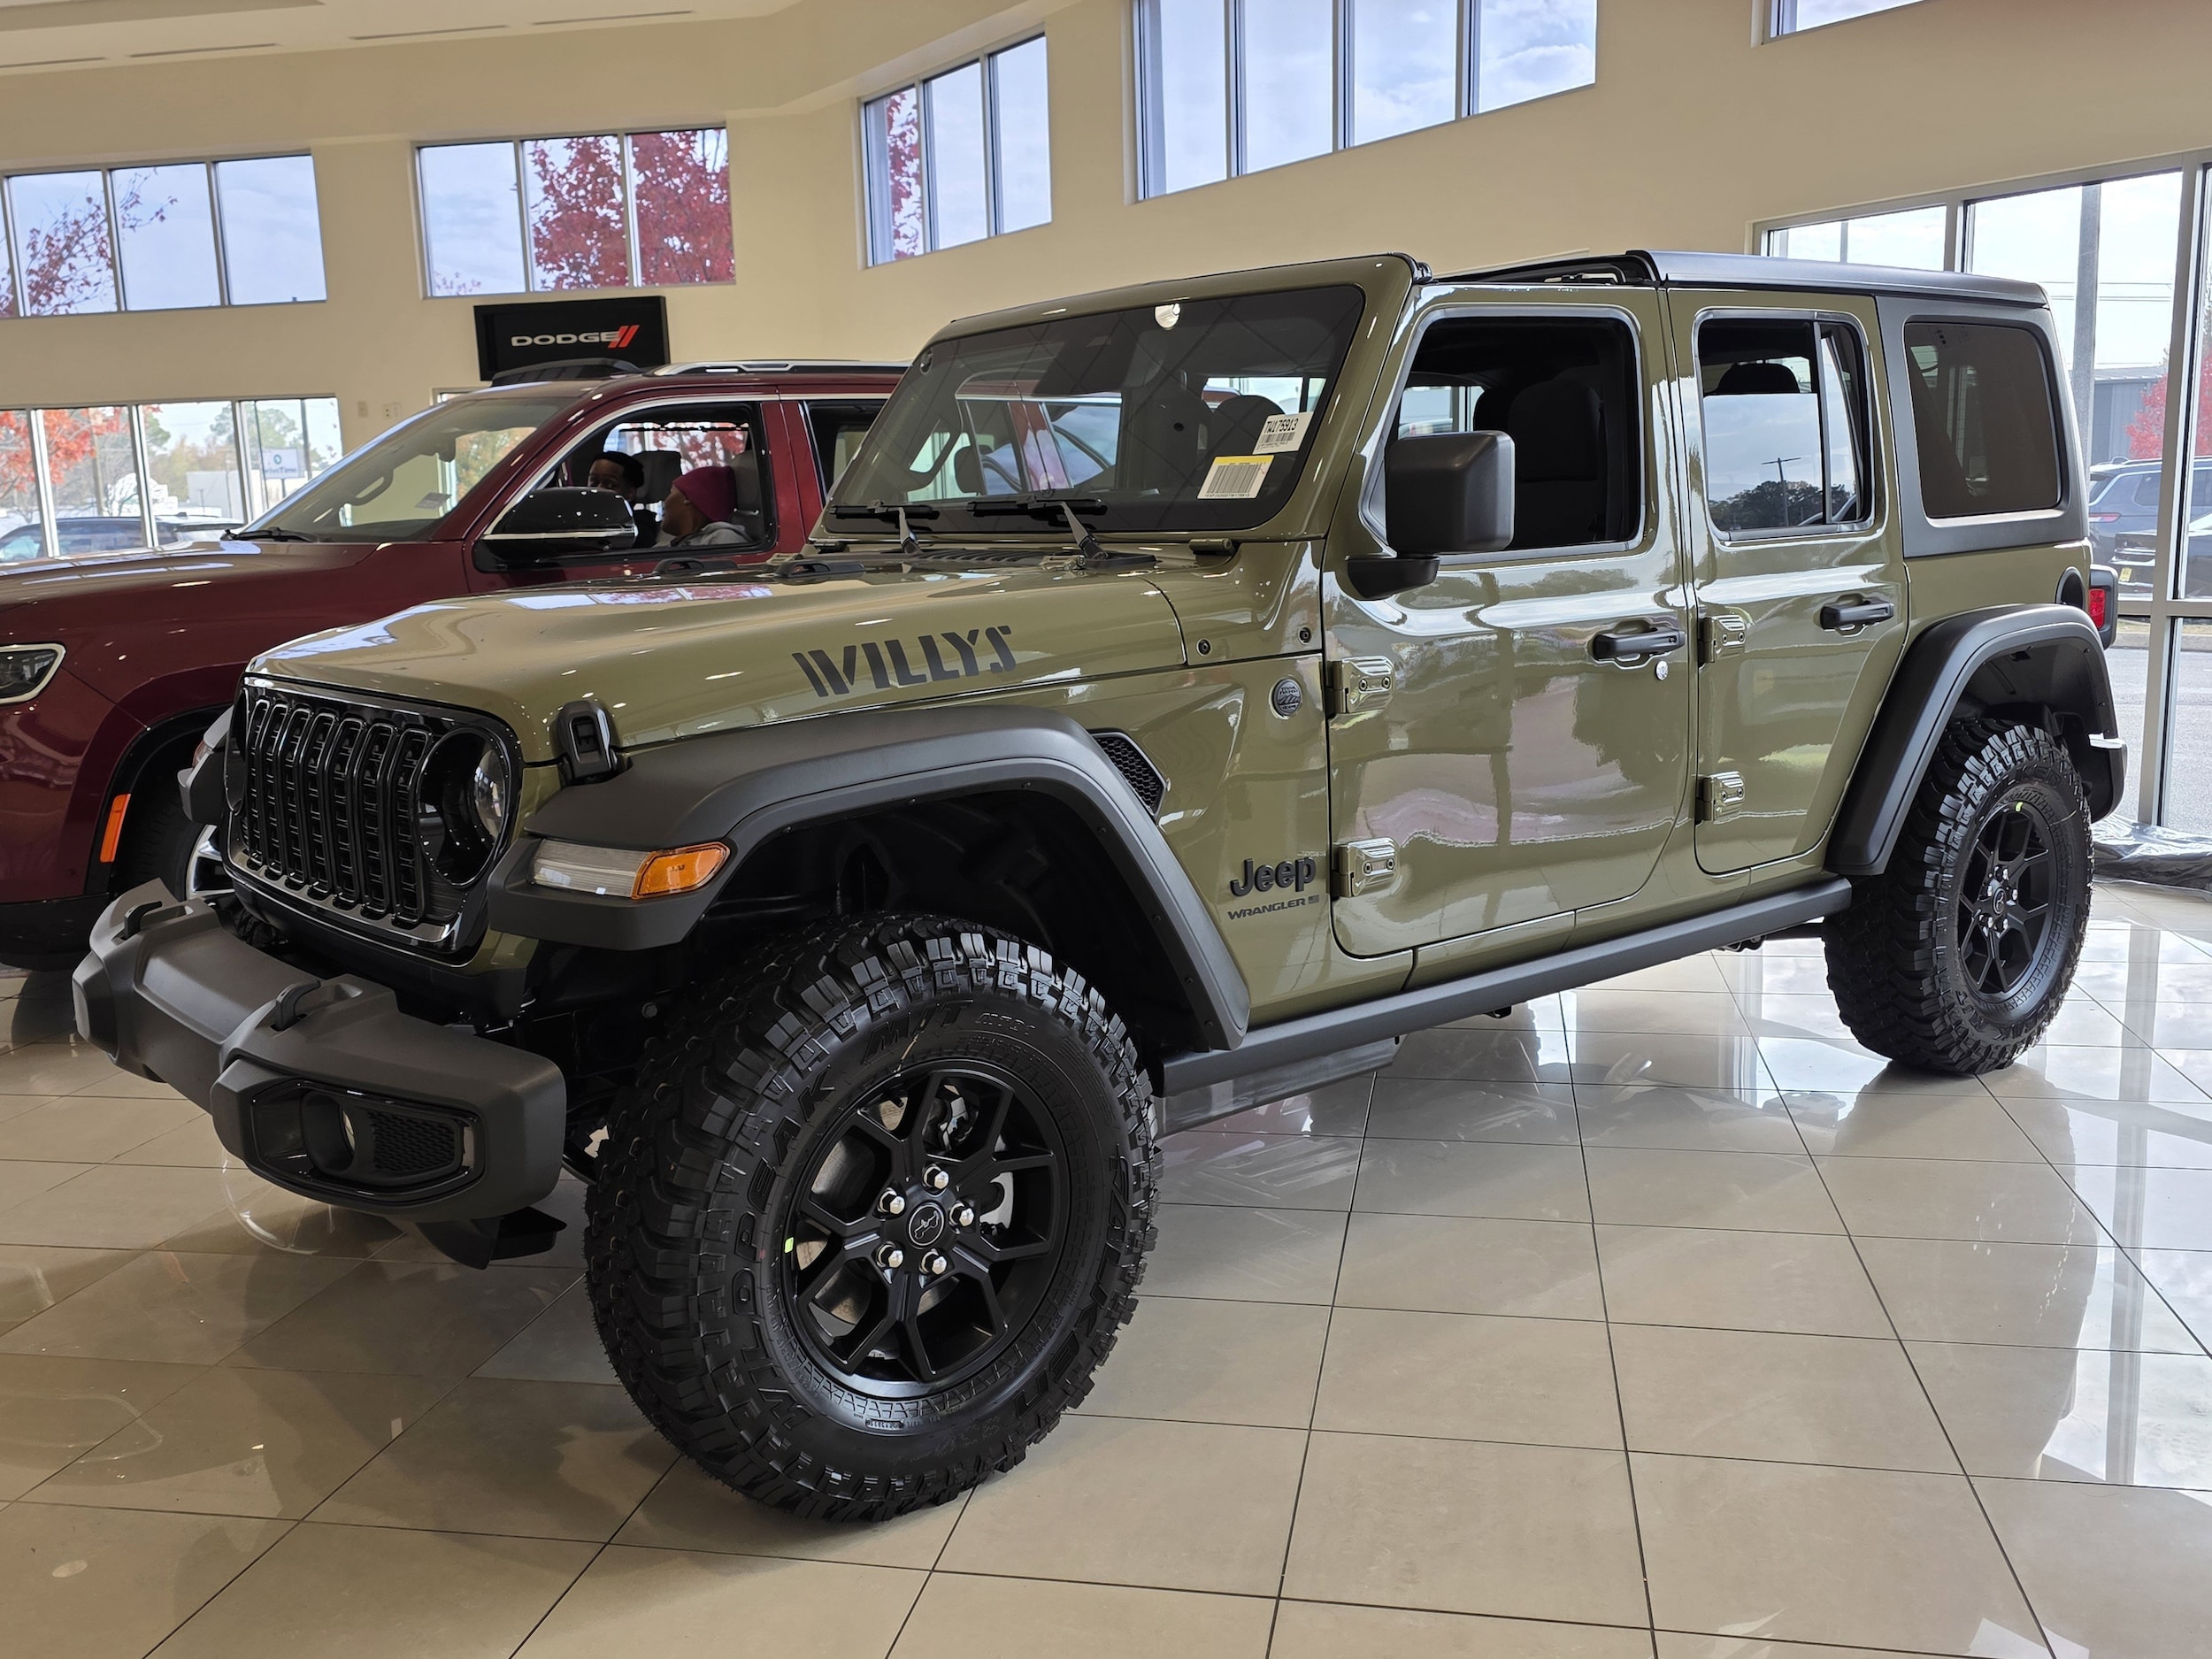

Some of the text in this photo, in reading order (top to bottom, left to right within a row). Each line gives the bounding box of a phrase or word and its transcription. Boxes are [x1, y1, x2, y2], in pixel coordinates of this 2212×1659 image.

[511, 331, 621, 347] DODGE
[791, 625, 1017, 697] WILLYS
[1229, 856, 1317, 897] Jeep
[1227, 897, 1306, 920] WRANGLER
[732, 1064, 835, 1430] WILDPEAK
